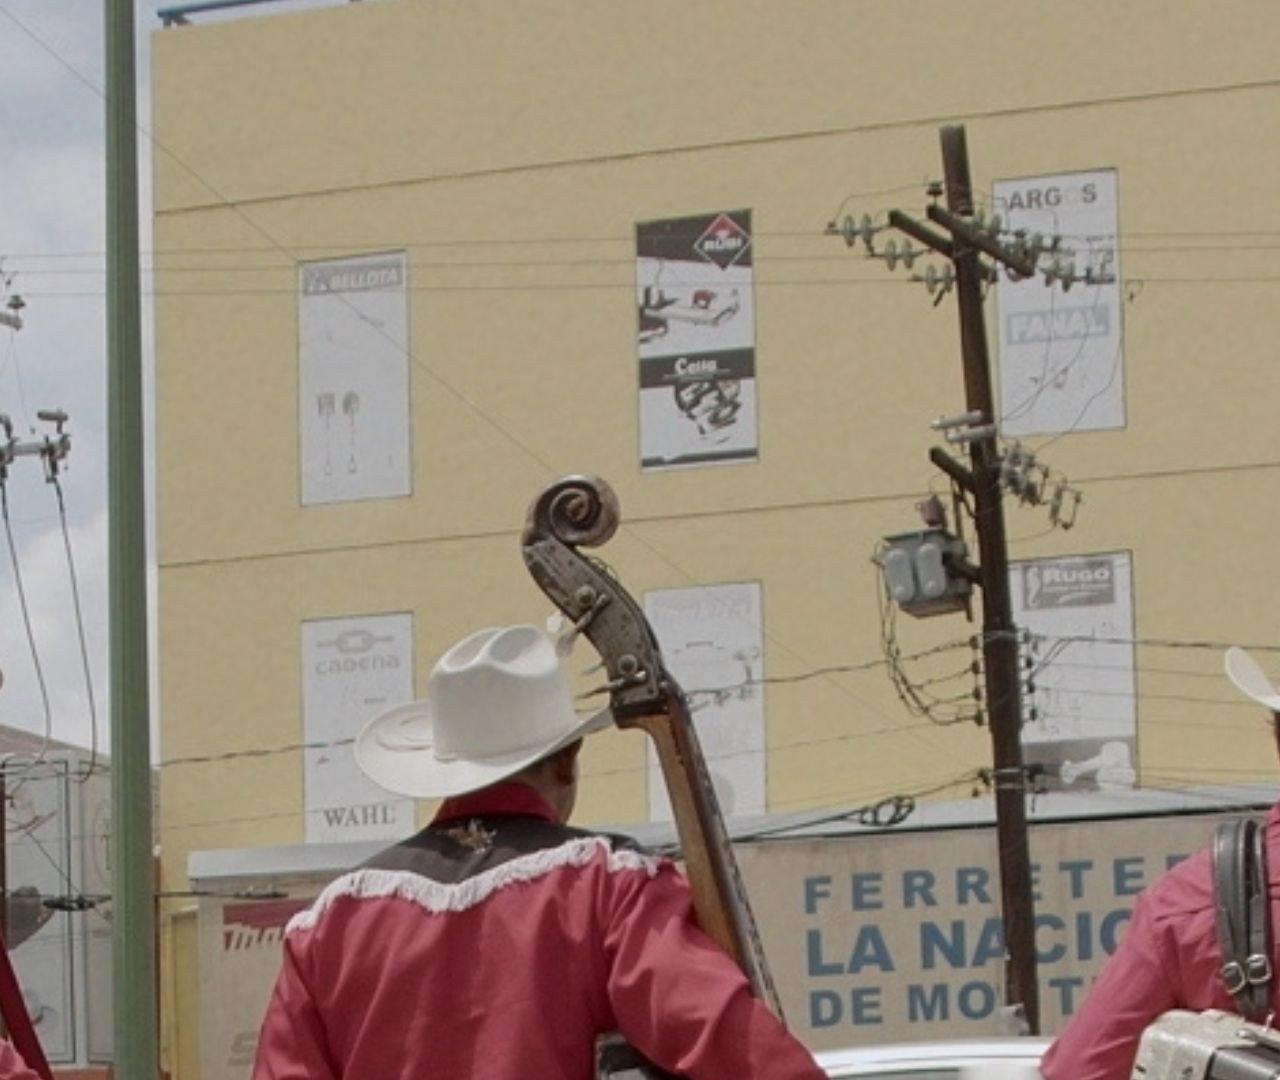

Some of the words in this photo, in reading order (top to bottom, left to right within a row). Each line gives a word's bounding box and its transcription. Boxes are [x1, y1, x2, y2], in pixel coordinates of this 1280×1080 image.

[1008, 182, 1098, 210] ARGS
[329, 267, 399, 290] BELLOTA
[323, 805, 396, 829] WAHL
[803, 853, 1191, 915] FERRTE
[806, 924, 895, 977] LA
[810, 985, 884, 1029] DE
